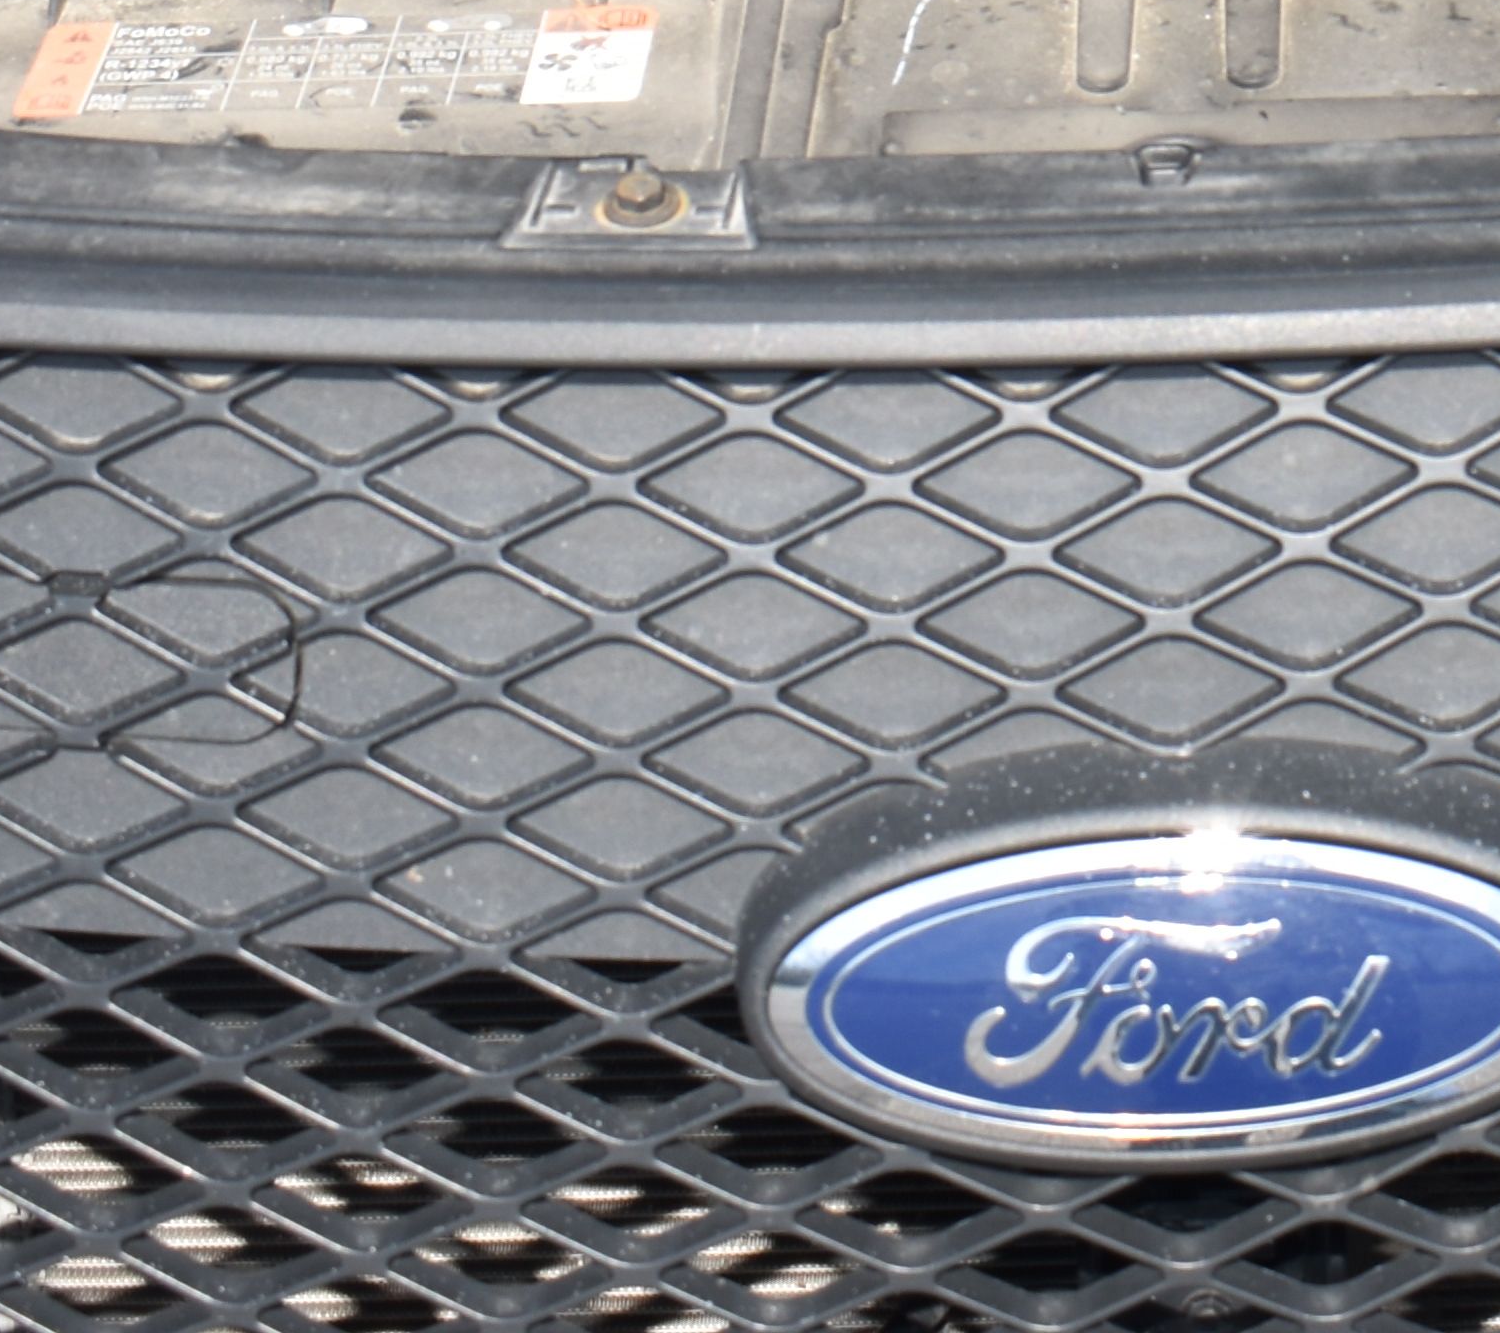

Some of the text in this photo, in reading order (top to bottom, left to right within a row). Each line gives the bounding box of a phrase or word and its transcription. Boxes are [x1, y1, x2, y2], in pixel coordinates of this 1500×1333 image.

[117, 26, 211, 38] FoMoCo
[104, 58, 192, 69] R-1234yf
[99, 68, 180, 82] (GWP 4)
[965, 914, 1390, 1090] Ford
